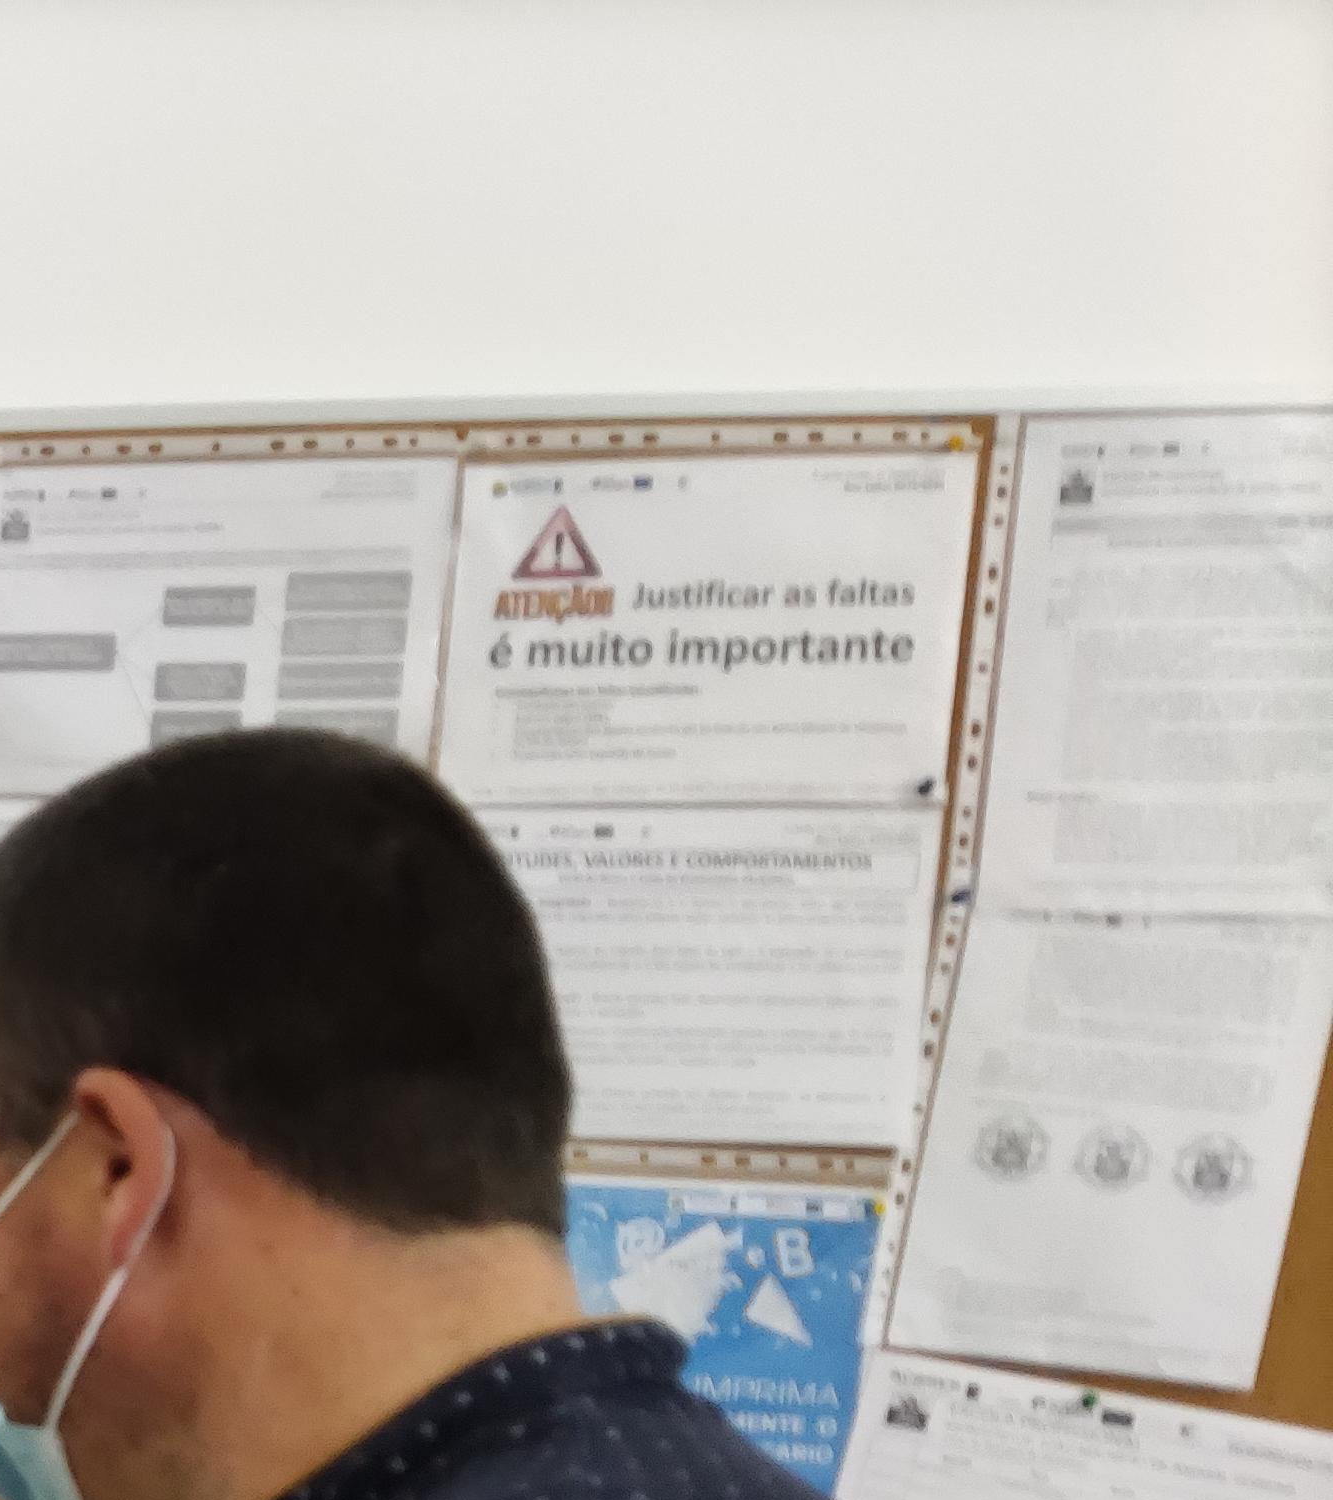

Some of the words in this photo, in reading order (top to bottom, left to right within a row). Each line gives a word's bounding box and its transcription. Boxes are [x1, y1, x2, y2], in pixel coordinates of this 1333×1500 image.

[633, 581, 774, 610] Justificar
[784, 584, 817, 608] as
[828, 578, 915, 607] faltas
[488, 633, 513, 668] é
[528, 629, 653, 668] muito
[668, 627, 915, 674] importante
